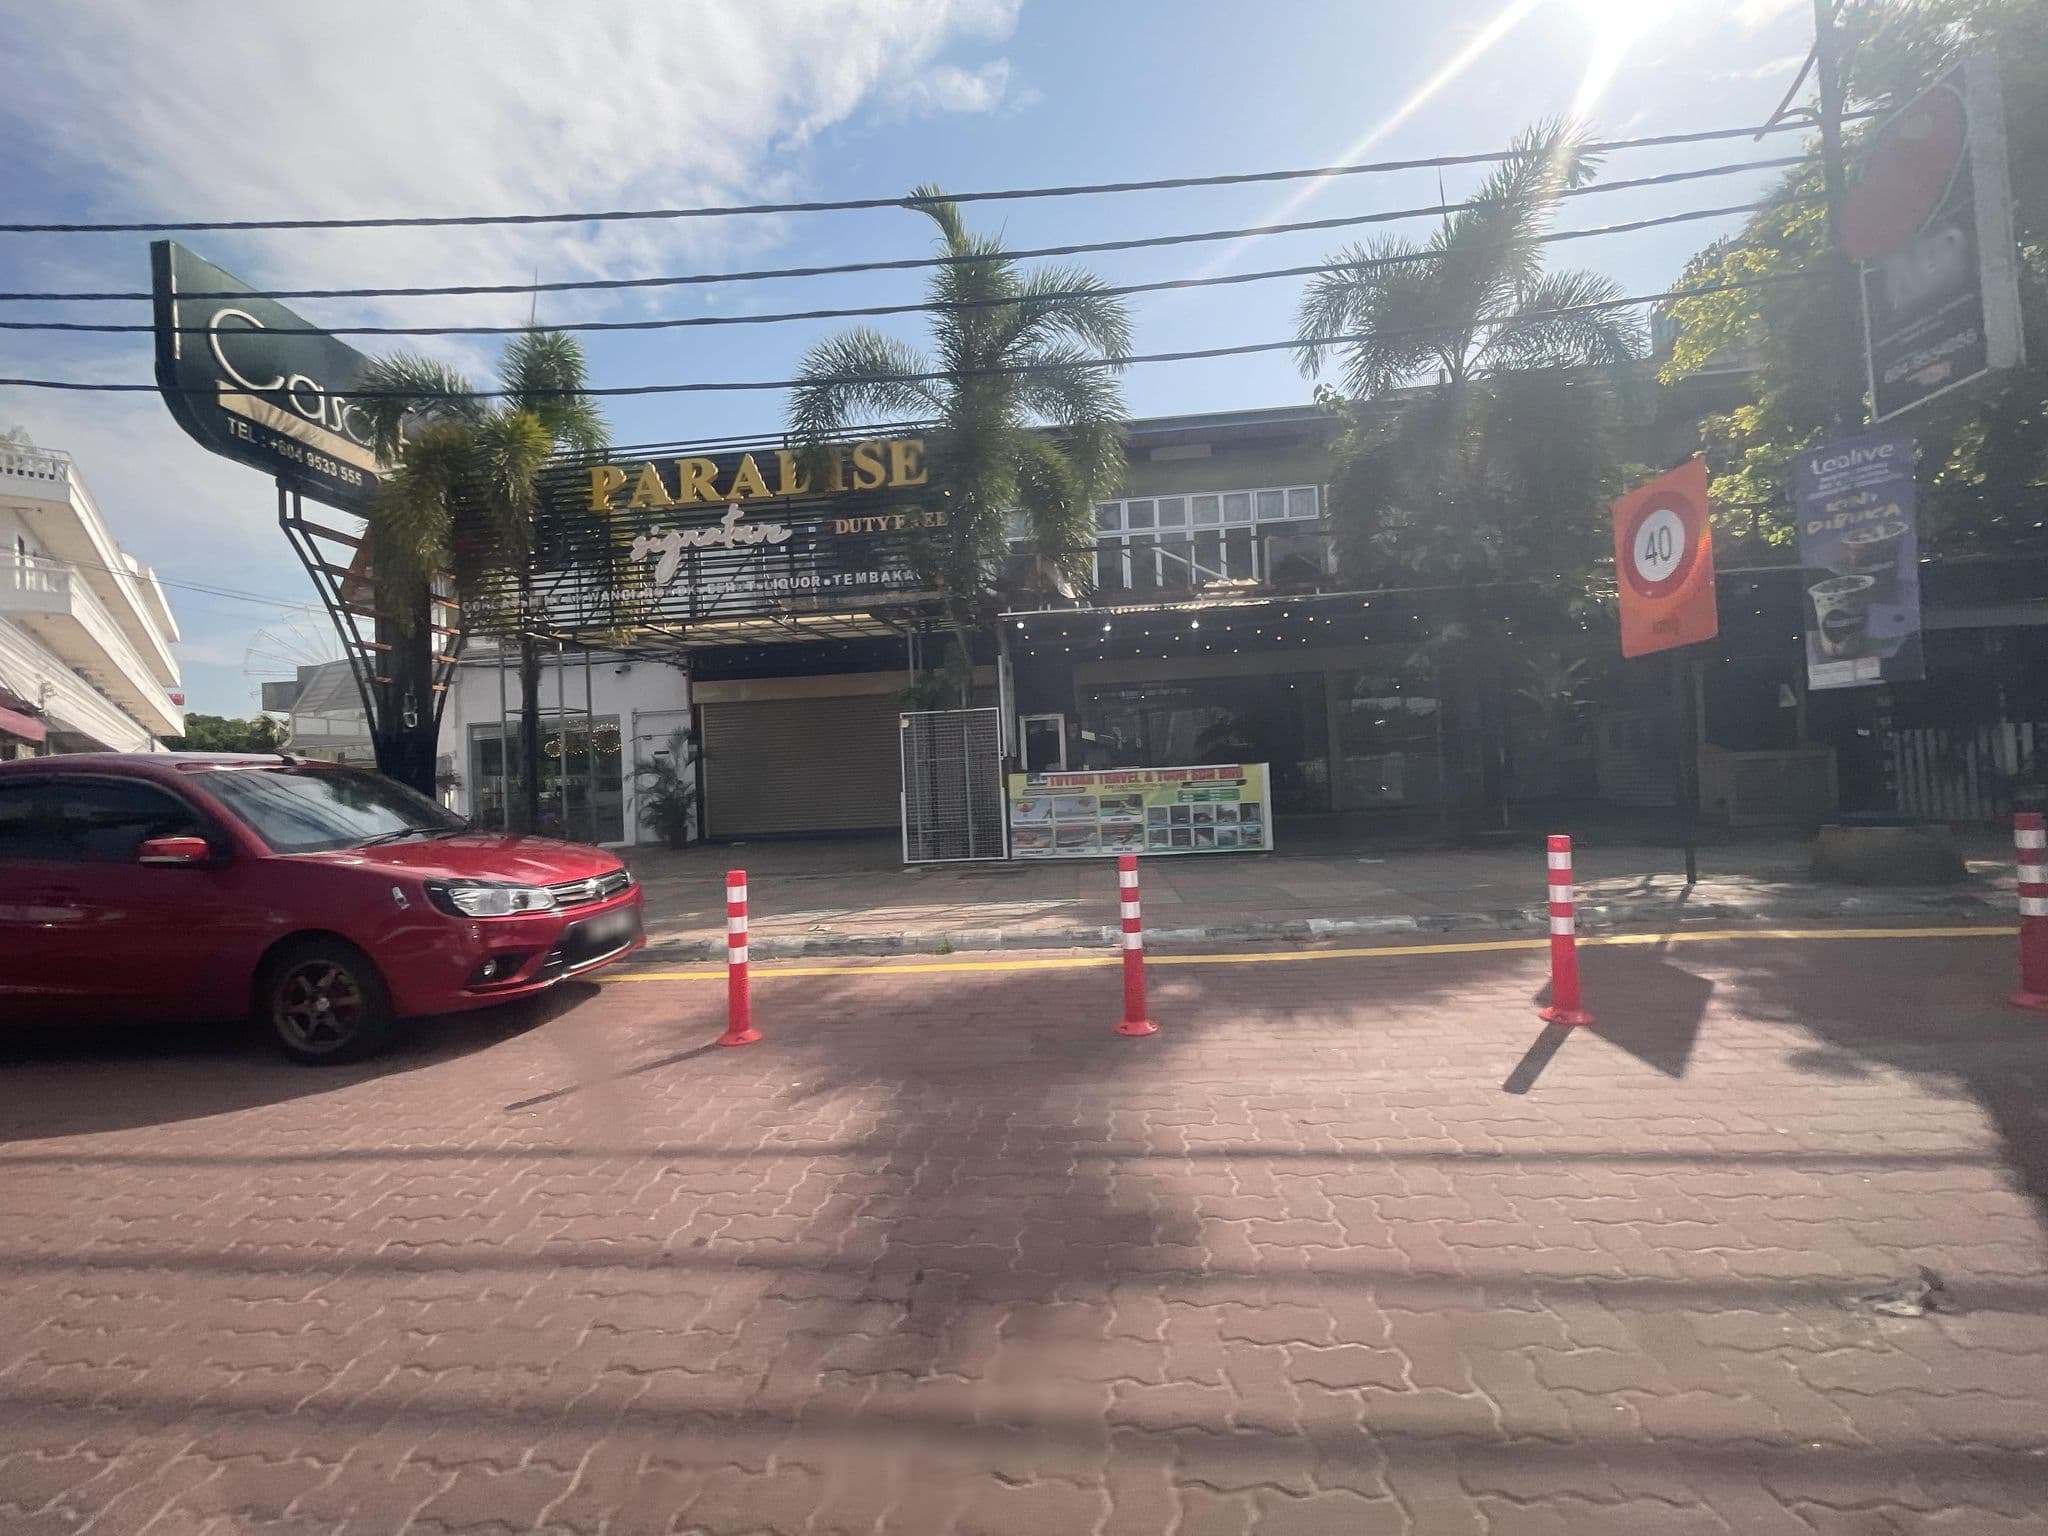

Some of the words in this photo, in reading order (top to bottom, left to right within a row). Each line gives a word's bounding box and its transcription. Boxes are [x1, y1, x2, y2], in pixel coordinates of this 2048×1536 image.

[226, 416, 258, 445] TEL
[306, 452, 339, 478] 9533
[340, 468, 364, 487] 555
[834, 515, 892, 535] DUTY
[893, 511, 949, 531] FEE
[1645, 525, 1672, 566] 40
[764, 575, 821, 591] LIQUOR
